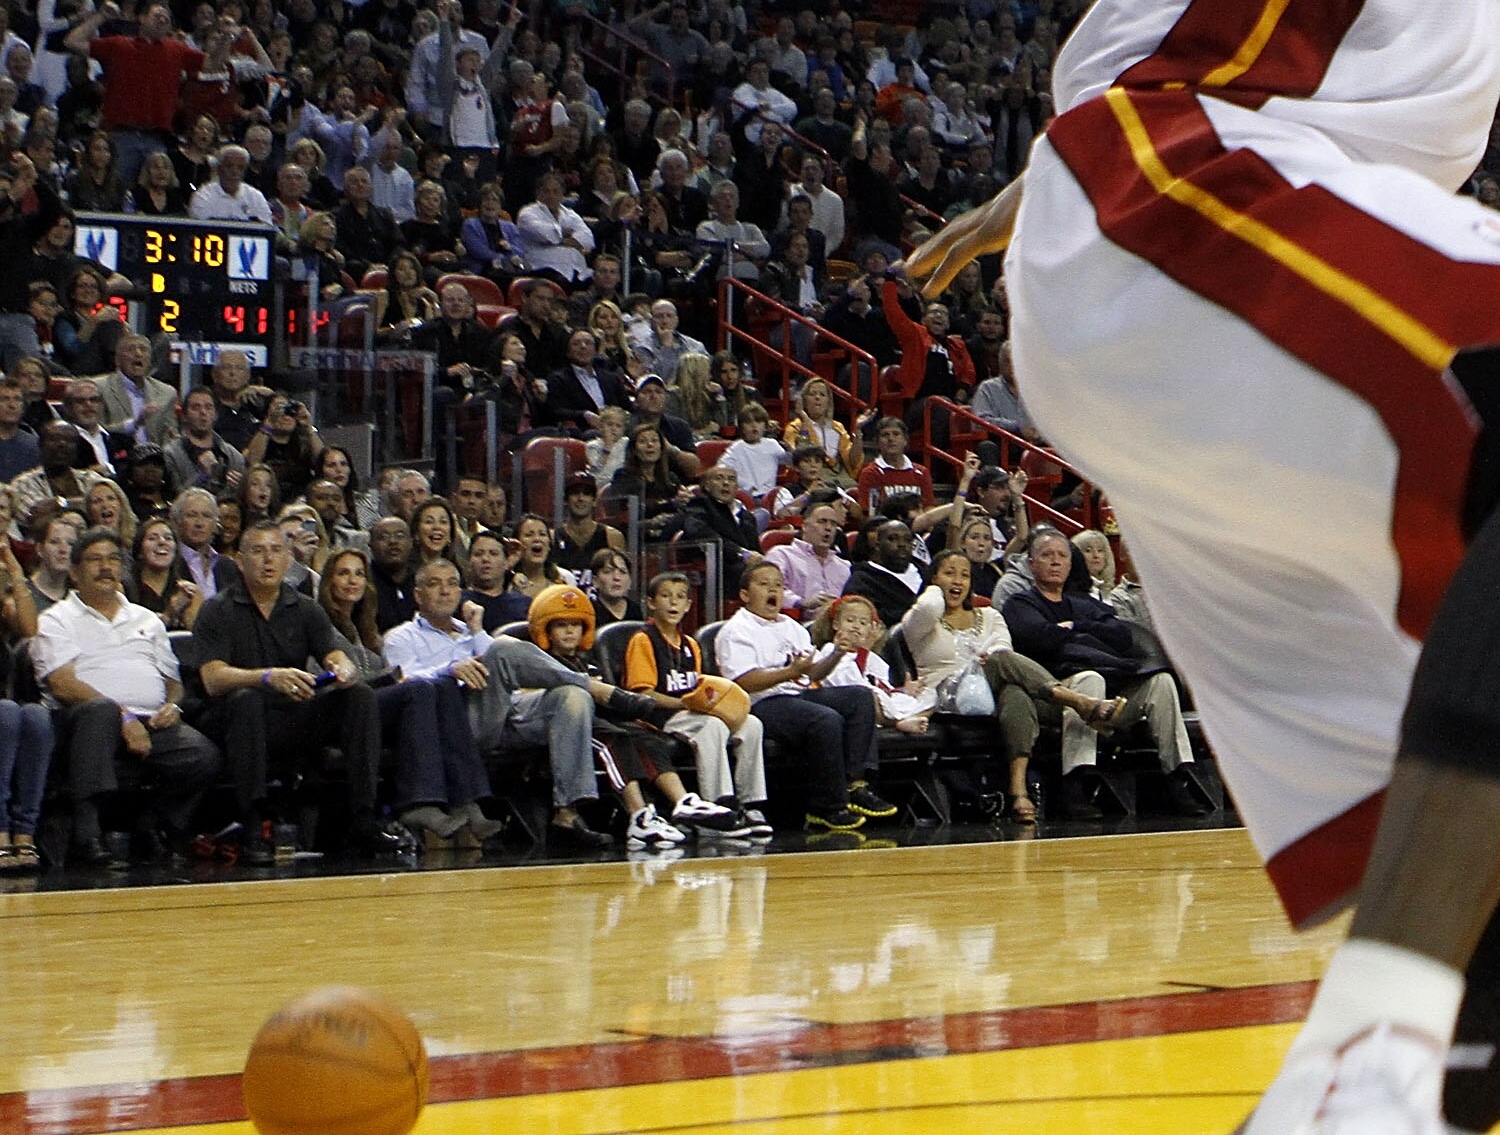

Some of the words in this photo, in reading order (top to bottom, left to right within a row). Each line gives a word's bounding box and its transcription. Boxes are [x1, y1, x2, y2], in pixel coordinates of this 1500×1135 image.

[144, 229, 224, 267] 3:10
[229, 280, 259, 295] NETS
[160, 299, 181, 333] 2
